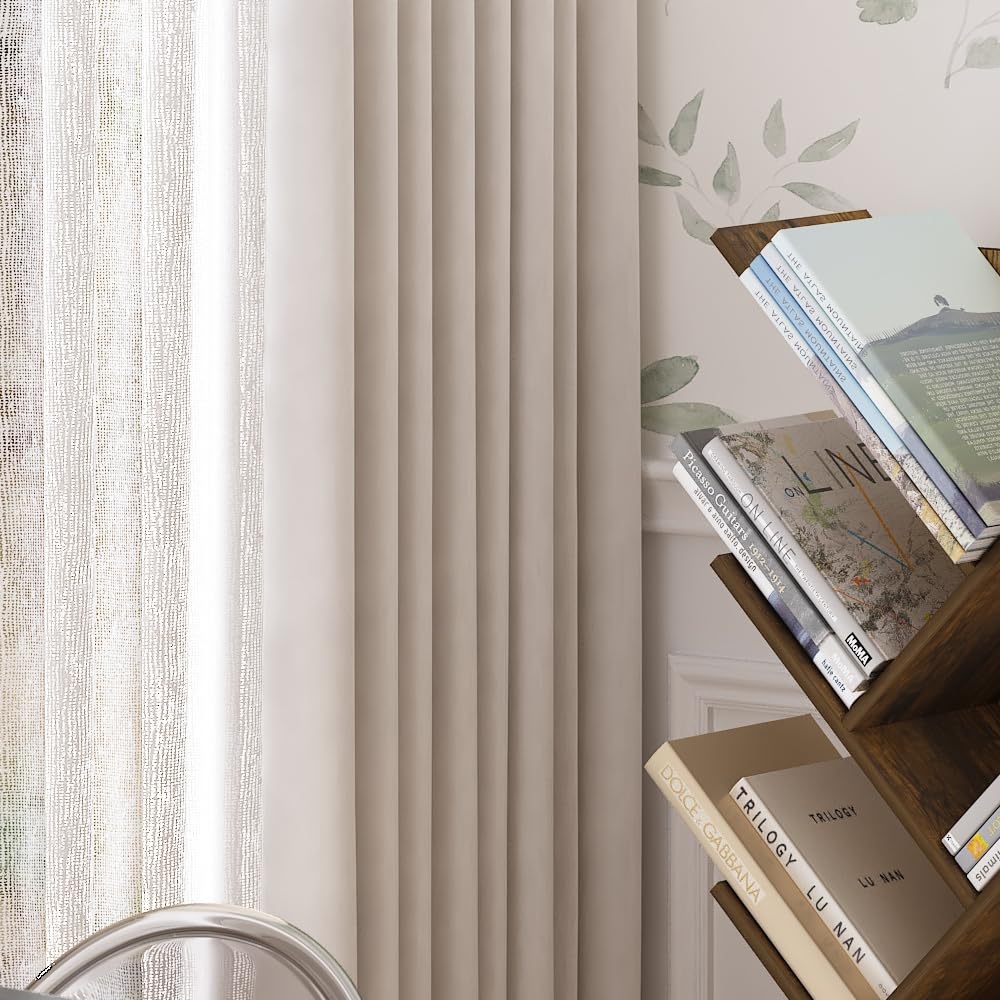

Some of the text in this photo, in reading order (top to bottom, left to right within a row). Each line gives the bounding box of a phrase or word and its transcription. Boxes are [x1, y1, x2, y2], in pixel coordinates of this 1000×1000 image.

[683, 450, 714, 495] Picasso
[715, 494, 748, 540] Guitars
[781, 443, 891, 497] ON LINE
[694, 488, 710, 506] alvar
[712, 513, 724, 528] aino
[738, 548, 757, 572] design
[741, 493, 796, 560] ON LINE
[822, 660, 846, 692] hatje cantz
[847, 634, 870, 665] MoMA
[660, 764, 700, 818] DOLCE
[703, 822, 761, 903] GABBANA
[808, 806, 857, 824] TRILOGY
[736, 786, 866, 964] TRILOGY LU NAN
[858, 870, 904, 888] LU NAN
